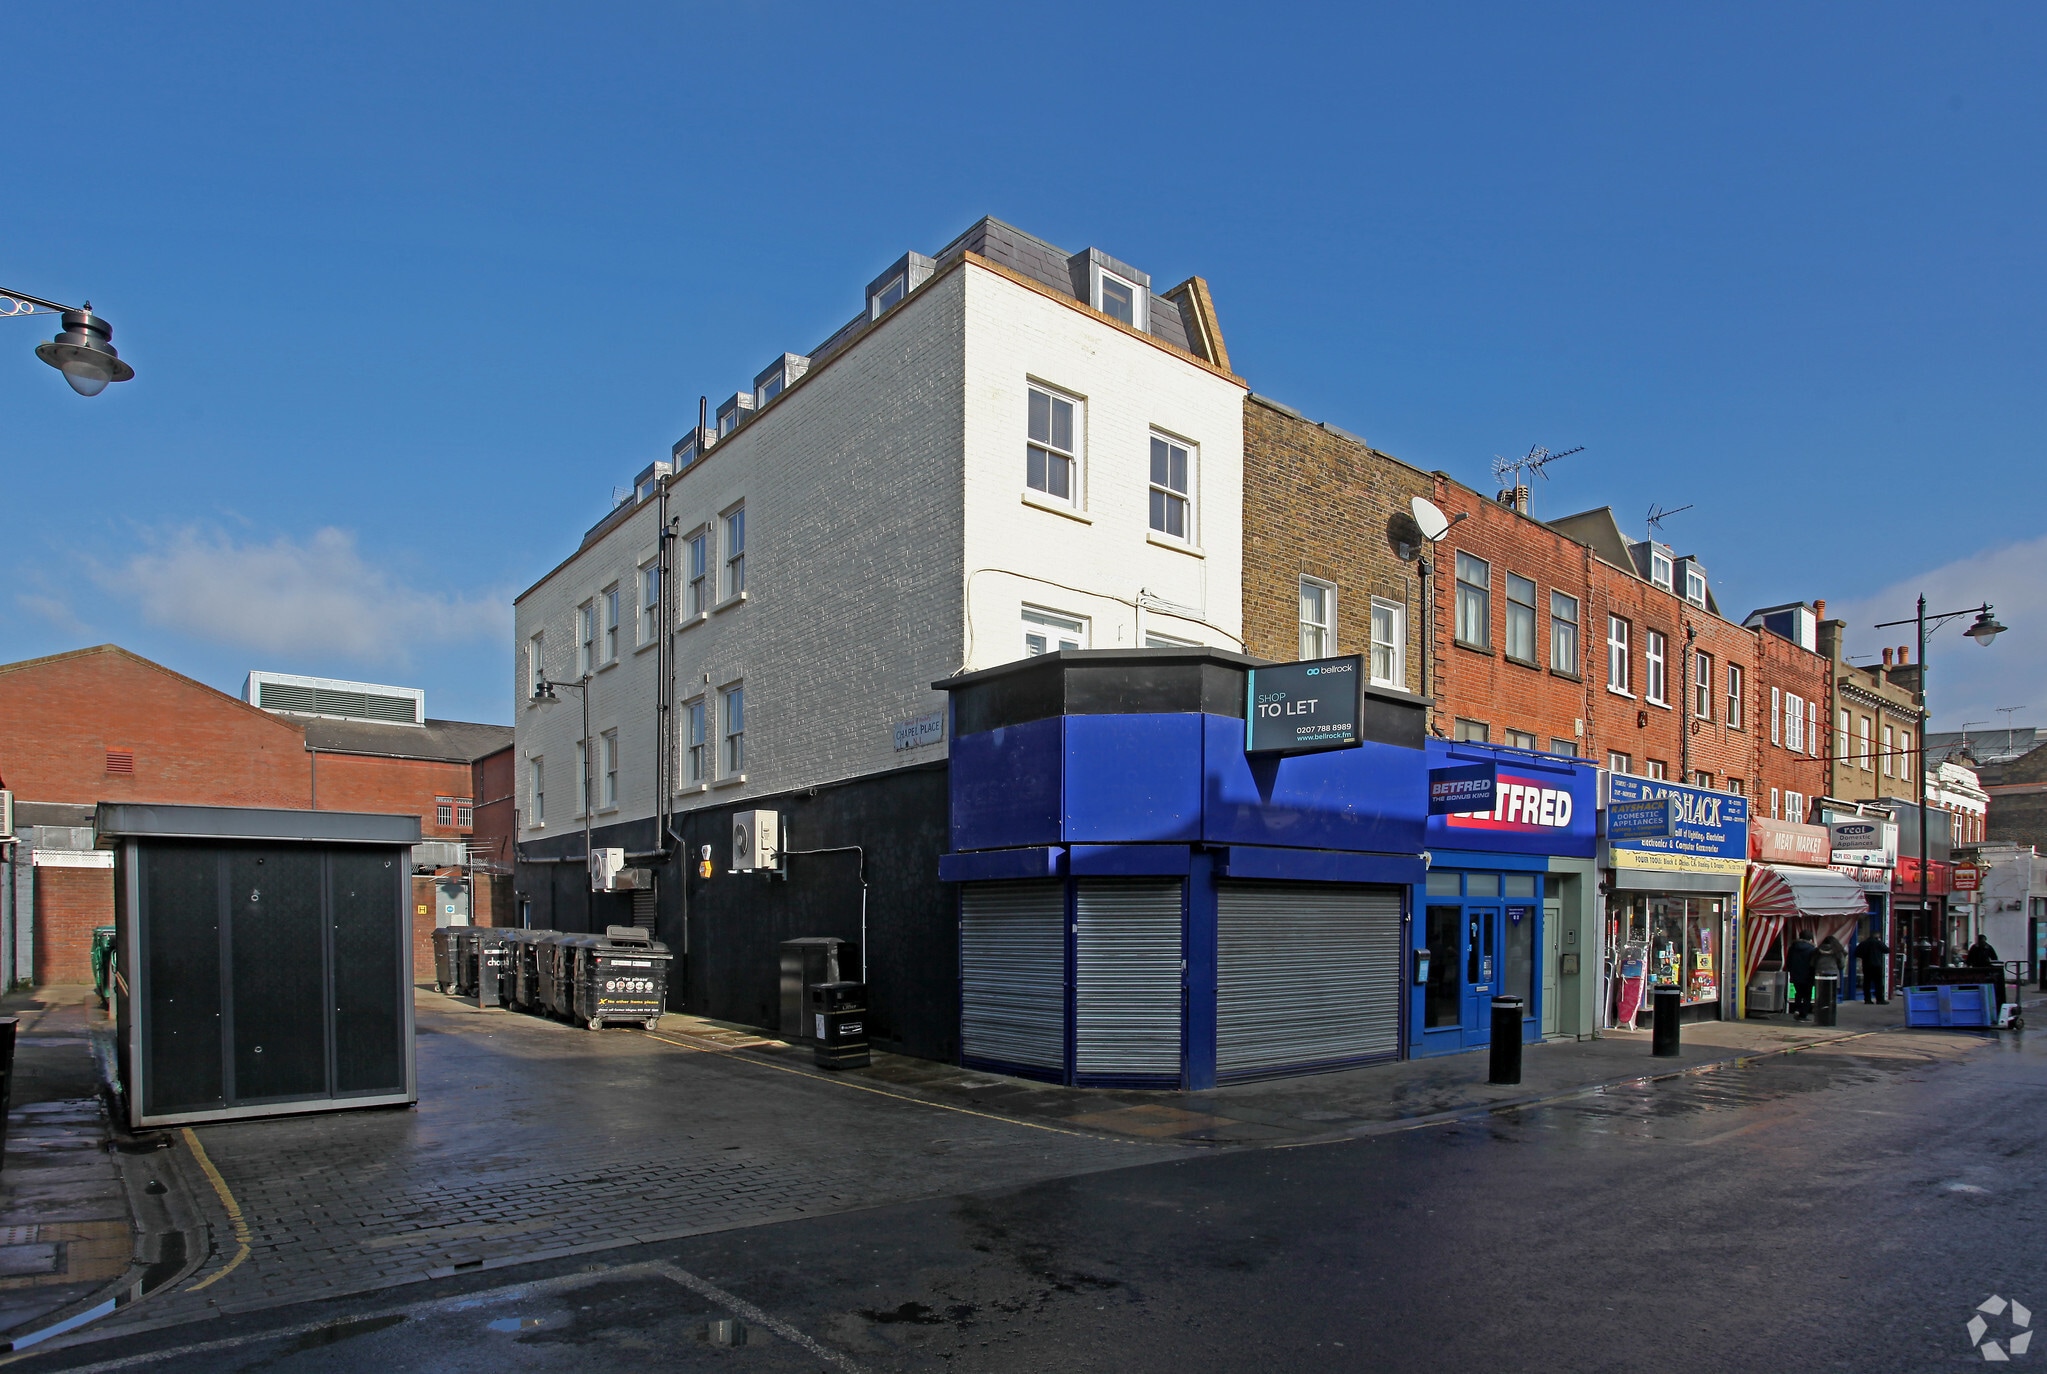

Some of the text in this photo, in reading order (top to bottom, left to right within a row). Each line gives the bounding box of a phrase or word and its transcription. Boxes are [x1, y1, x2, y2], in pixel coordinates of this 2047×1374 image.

[1321, 664, 1352, 674] bellrock
[1258, 692, 1286, 703] SHOP
[1258, 699, 1318, 718] TO LET
[896, 727, 918, 740] CHAPEL
[920, 721, 940, 734] PLACE
[1296, 726, 1315, 734] 0207
[1332, 723, 1352, 731] 8989
[1296, 732, 1352, 741] www.bellrock.fm
[1432, 779, 1491, 795] BETFRED
[1446, 793, 1471, 801] BONUS
[1453, 782, 1572, 827] TFRED
[1611, 802, 1665, 813] RAYSHACK
[1617, 811, 1659, 820] DOMESTIC
[1613, 818, 1664, 827] APPLIANCES
[1843, 826, 1865, 834] real
[1774, 832, 1822, 854] MEAT MARKET
